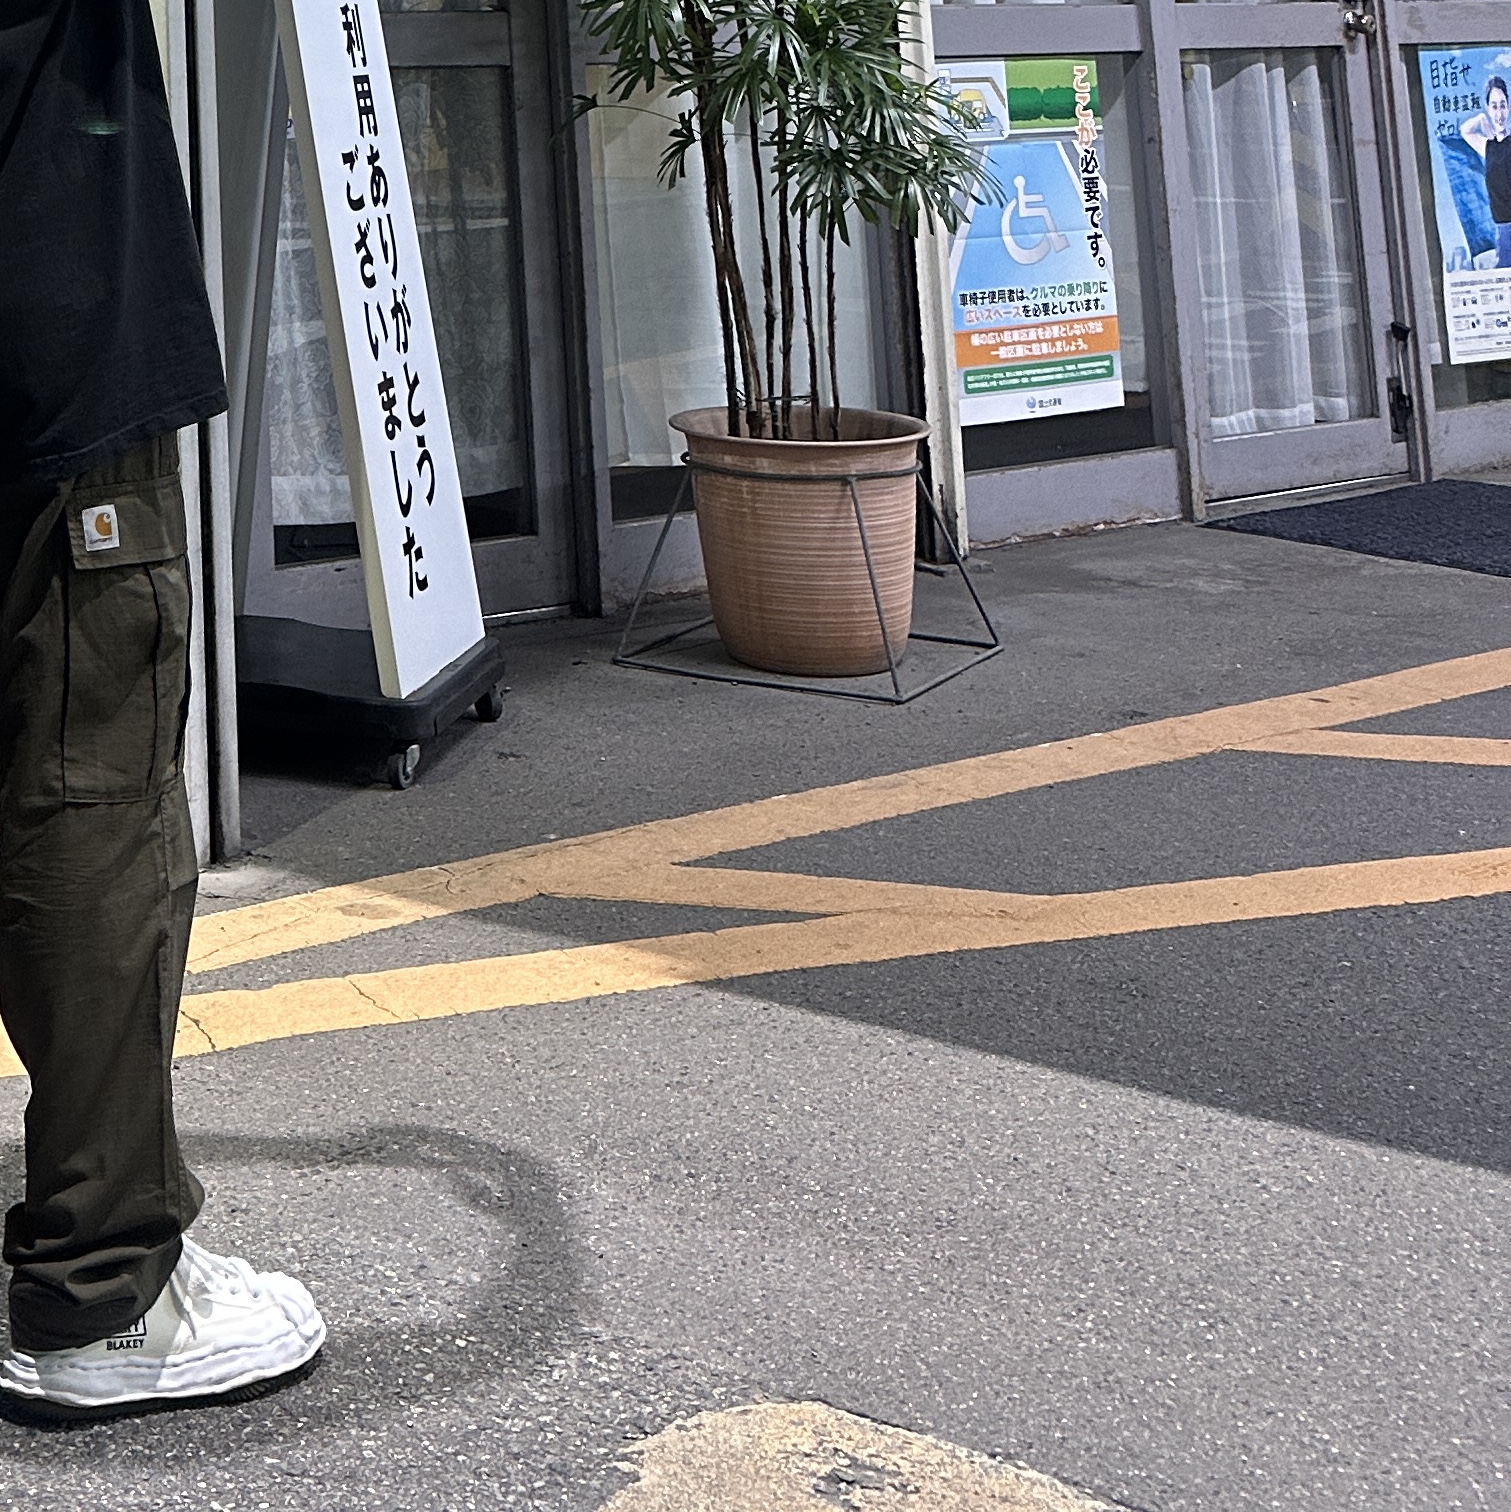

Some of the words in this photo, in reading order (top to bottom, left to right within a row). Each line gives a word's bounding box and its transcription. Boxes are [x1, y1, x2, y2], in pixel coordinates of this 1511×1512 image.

[1073, 65, 1106, 268] ここが必要です。
[342, 149, 431, 601] ございました
[366, 147, 437, 509] ありがとう
[106, 1338, 145, 1351] BLAKEY
